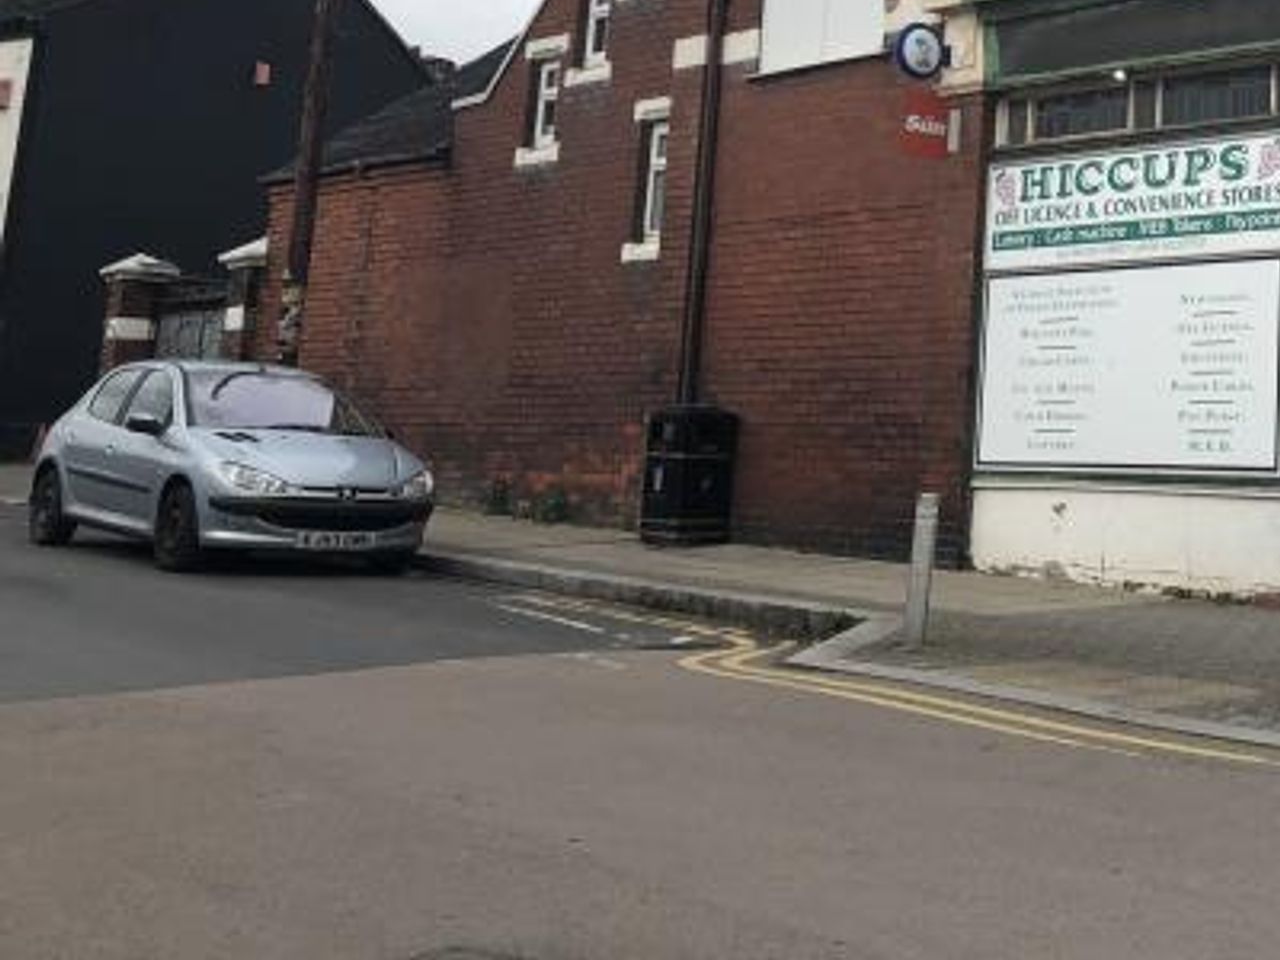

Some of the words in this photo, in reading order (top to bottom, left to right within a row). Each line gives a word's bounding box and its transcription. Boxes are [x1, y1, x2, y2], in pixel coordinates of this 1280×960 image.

[1019, 143, 1249, 203] HICCUPS
[995, 208, 1019, 225] OFF
[1024, 202, 1081, 224] LICENCE
[1085, 202, 1098, 219] &
[1104, 189, 1217, 215] CONVENIENCE
